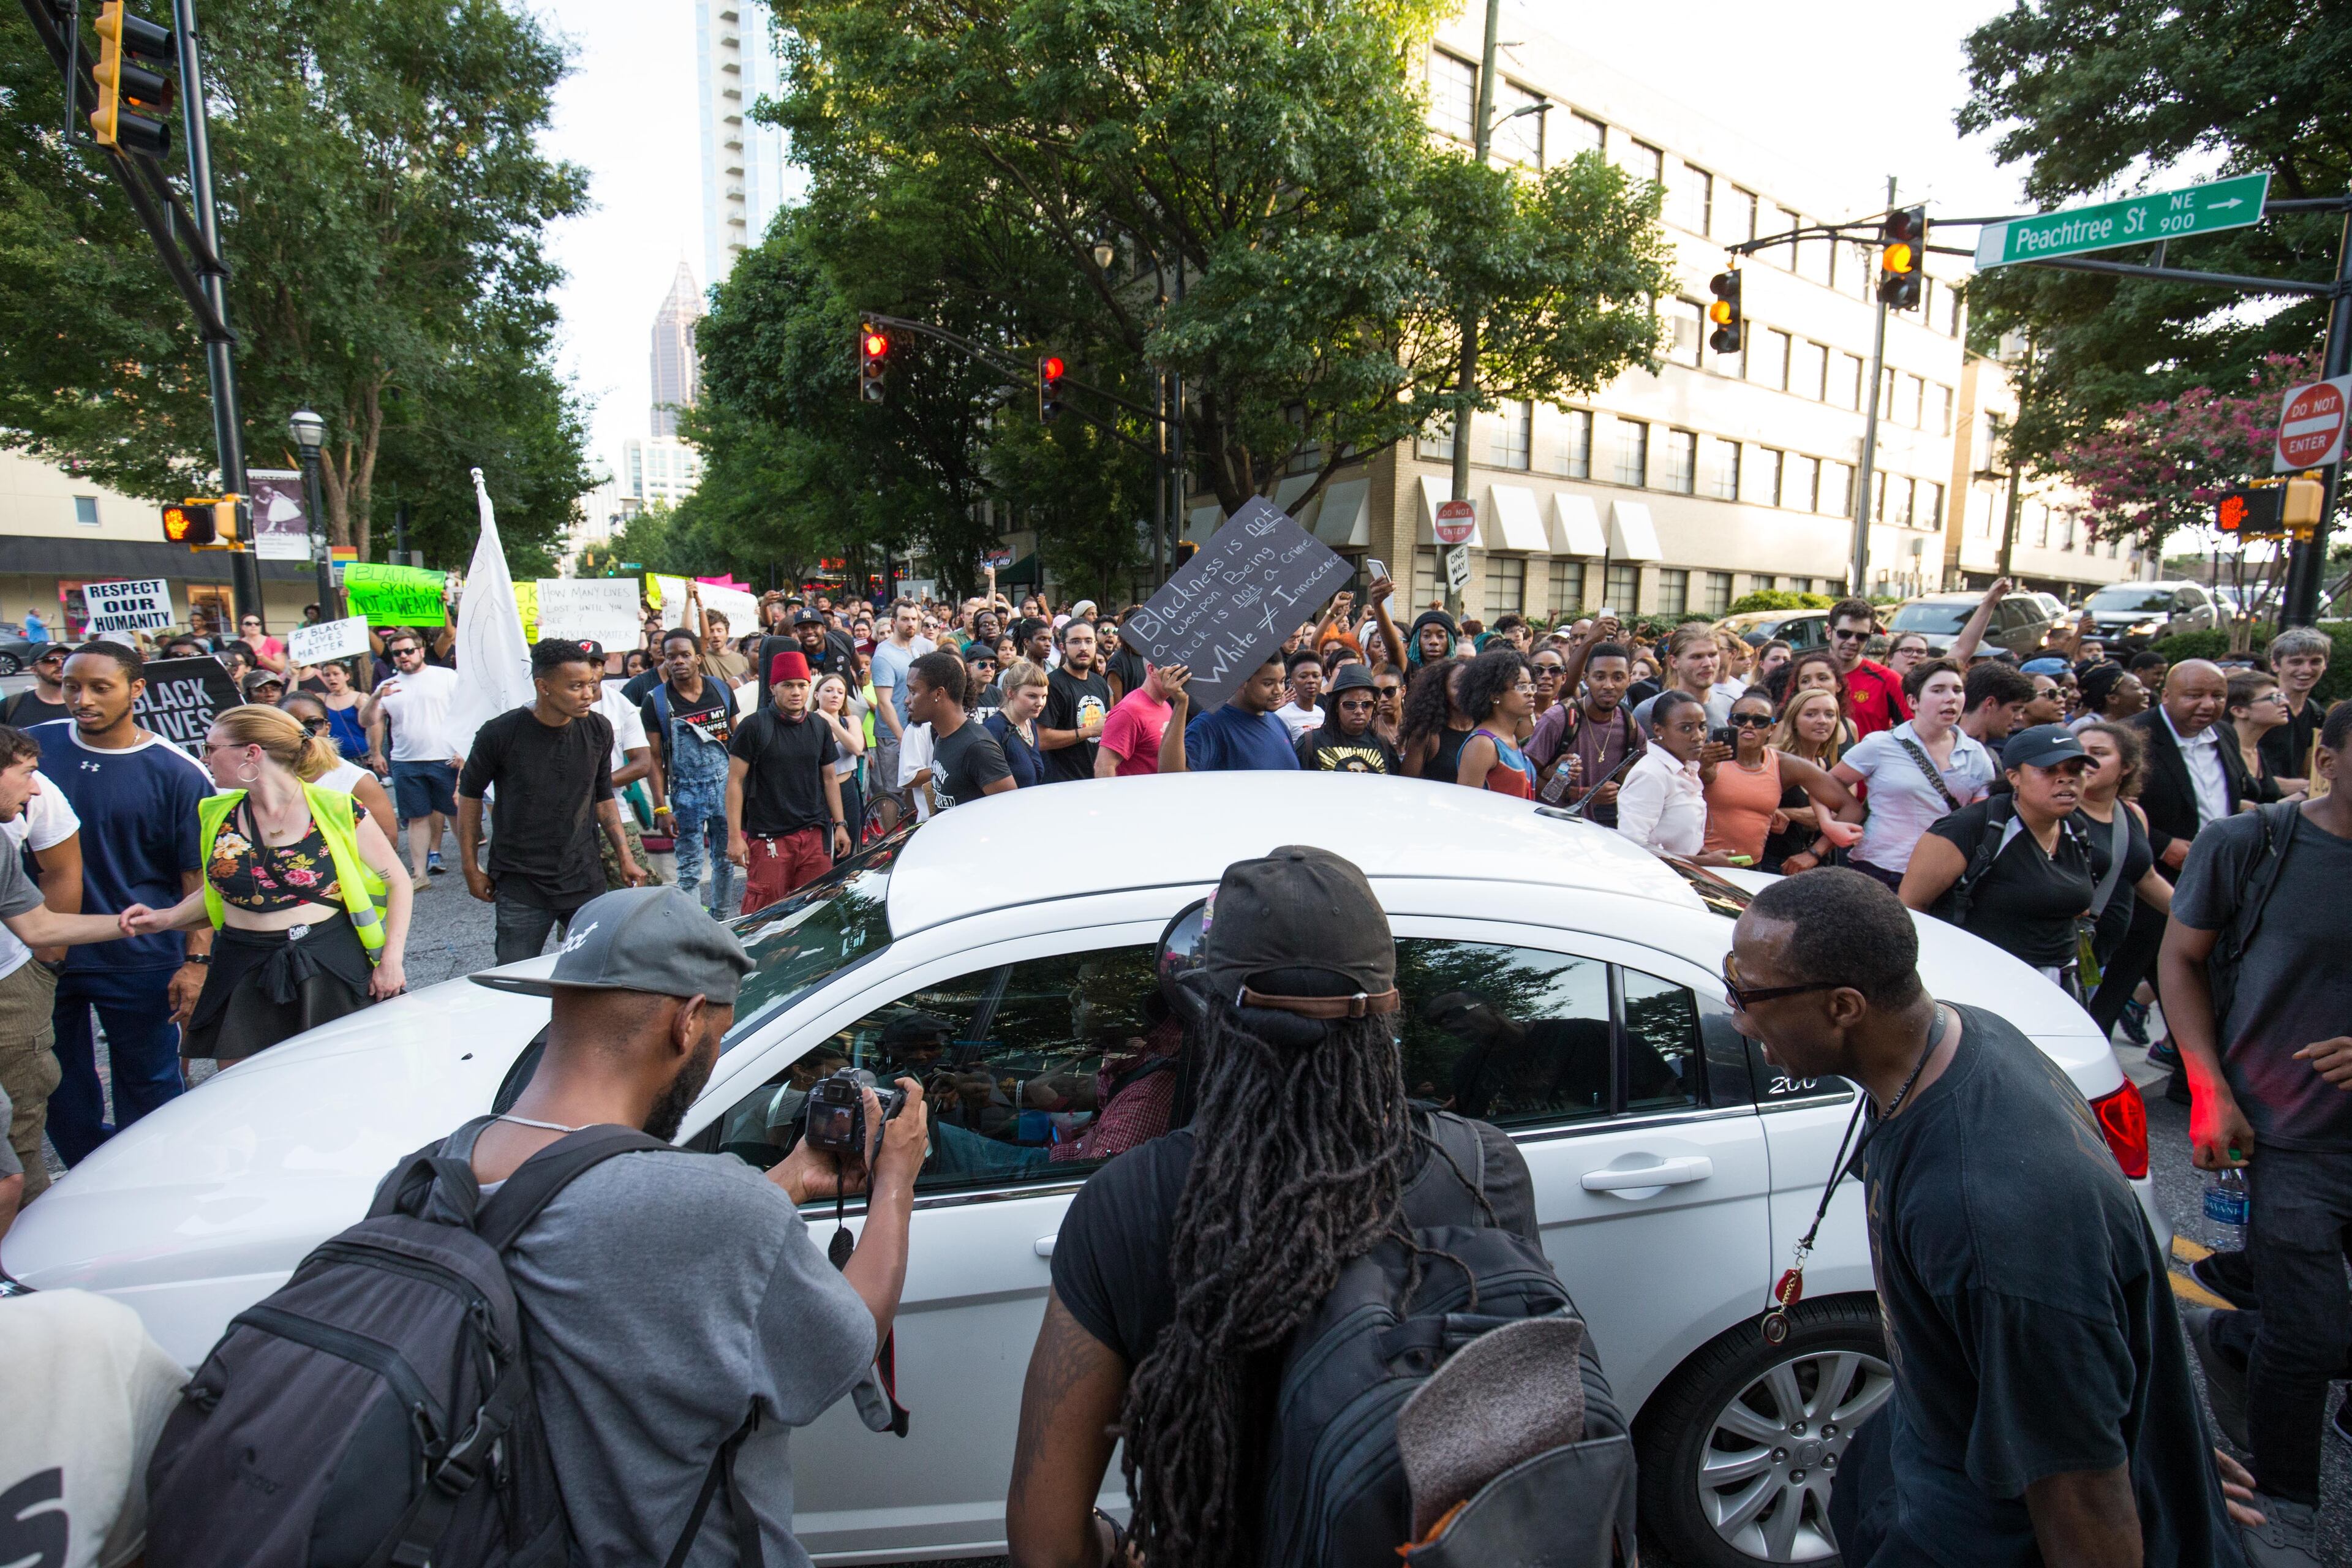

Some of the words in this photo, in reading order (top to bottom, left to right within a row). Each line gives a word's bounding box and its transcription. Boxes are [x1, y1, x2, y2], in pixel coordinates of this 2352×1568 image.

[2169, 192, 2195, 211] NE
[2016, 217, 2113, 253] Peachtree
[2124, 206, 2147, 235] St
[2160, 213, 2195, 233] 900
[2292, 402, 2308, 418] DO
[2313, 396, 2337, 413] NOT
[2289, 434, 2326, 454] ENTER
[1456, 508, 1469, 516] NOT
[1450, 548, 1464, 564] ONE
[355, 566, 410, 582] BLACK
[1129, 558, 1224, 641] Blackness
[1224, 539, 1242, 555] is
[1245, 507, 1273, 537] not
[1451, 560, 1465, 576] WAY
[89, 581, 160, 598] RESPECT
[380, 582, 417, 596] SKIN
[571, 587, 599, 599] MANY
[603, 587, 630, 597] LIVES
[1212, 610, 1228, 624] is
[1232, 583, 1256, 605] not
[1264, 569, 1279, 581] a
[104, 598, 156, 612] OUR
[355, 595, 380, 613] NOT
[383, 601, 393, 612] a
[395, 595, 444, 615] WEAPON
[1153, 644, 1169, 657] a
[1223, 548, 1275, 585] Being
[94, 611, 170, 632] HUMANITY
[1190, 631, 1257, 683] White
[1271, 554, 1340, 606] Innocence
[311, 621, 349, 636] BLACK
[309, 631, 342, 646] LIVES
[298, 641, 344, 658] MATTER
[710, 709, 725, 719] MY
[1768, 1076, 1817, 1094] 200
